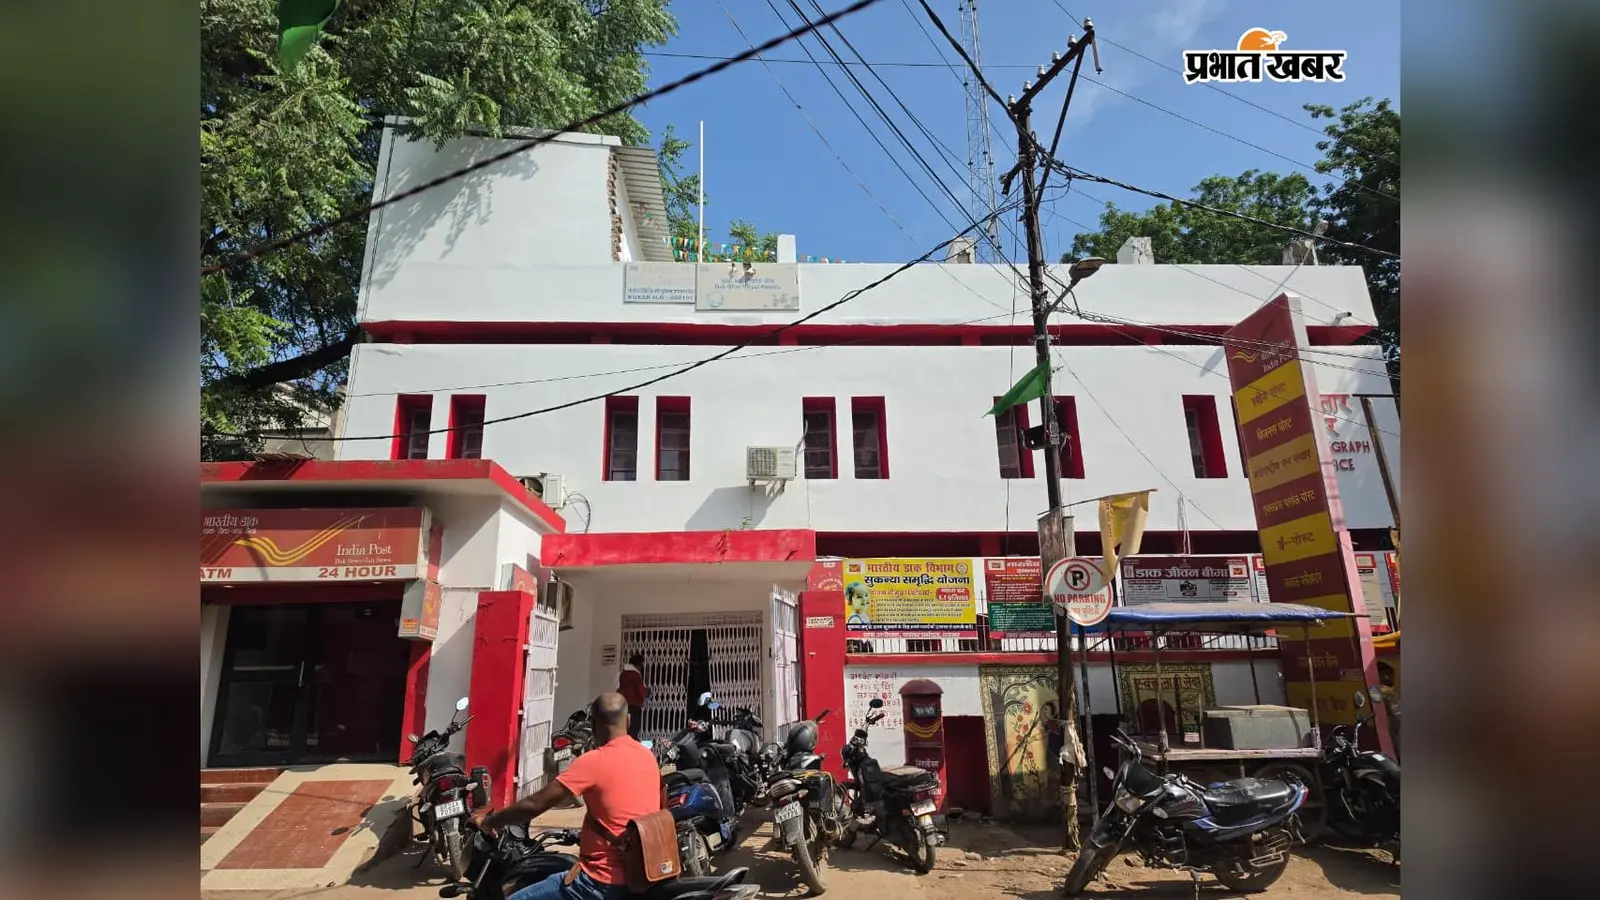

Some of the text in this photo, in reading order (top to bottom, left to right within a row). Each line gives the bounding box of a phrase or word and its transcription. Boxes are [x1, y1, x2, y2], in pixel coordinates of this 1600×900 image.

[1330, 440, 1370, 454] GRAPH
[1333, 458, 1355, 472] ICE
[203, 512, 238, 527] भारतीय
[336, 543, 393, 556] India Post
[318, 565, 397, 578] 24 HOUR
[867, 562, 954, 573] भारतीय डाक विभाग
[1135, 565, 1228, 578] डाक जीवन बीमा
[864, 573, 970, 588] सुकन्या समृद्धि योजना
[1053, 593, 1106, 603] NO PARKING
